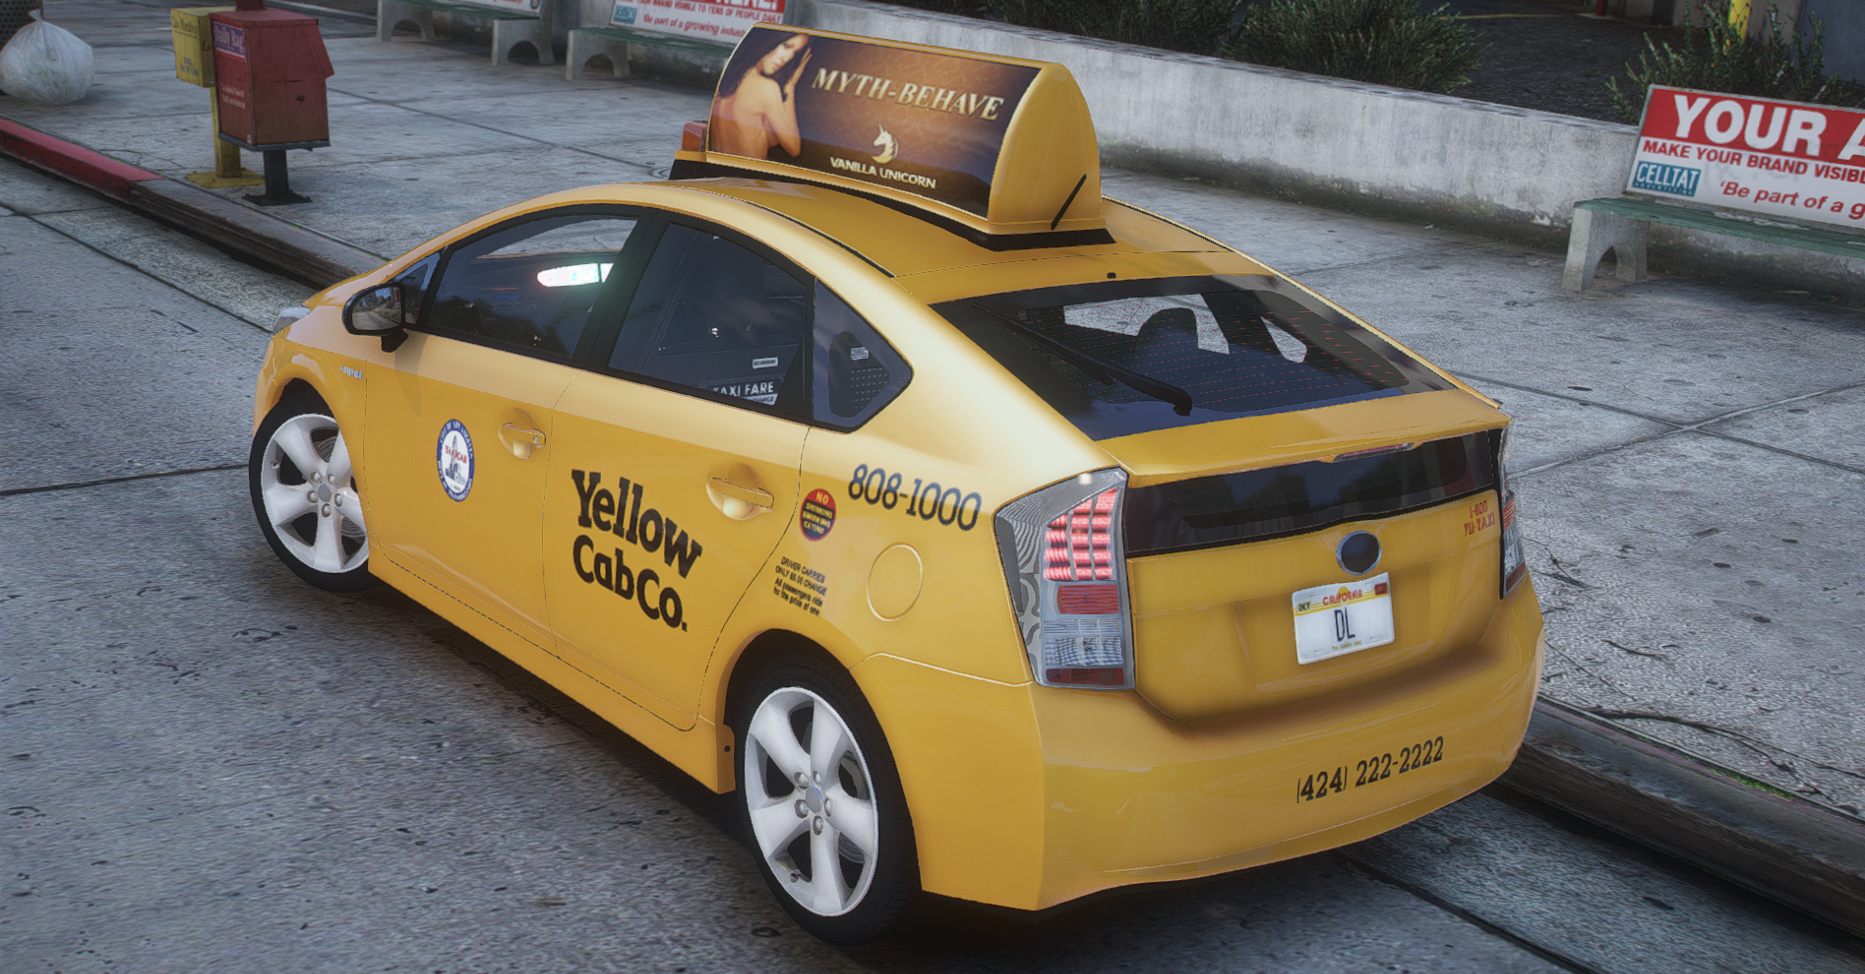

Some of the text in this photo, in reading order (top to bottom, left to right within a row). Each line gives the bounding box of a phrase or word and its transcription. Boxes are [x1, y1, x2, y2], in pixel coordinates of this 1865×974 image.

[811, 67, 1005, 121] MYTH-BEHAVE
[1673, 94, 1828, 157] YOUR
[830, 156, 937, 190] VANILLA UNICORN
[1636, 162, 1699, 191] CELLTAT
[1642, 139, 1865, 185] MAKE YOUR BRAND VISIBL
[1753, 189, 1799, 207] part
[1803, 195, 1829, 210] of
[1830, 200, 1844, 213] a
[744, 380, 775, 396] FARE
[815, 491, 830, 505] NO
[847, 463, 983, 532] 808-1000
[570, 468, 704, 580] Yellow
[803, 578, 828, 597] CHANGE
[1322, 588, 1363, 606] CALIFORNIA
[1333, 605, 1356, 643] DL
[1296, 735, 1444, 804] (424) 222-2222
